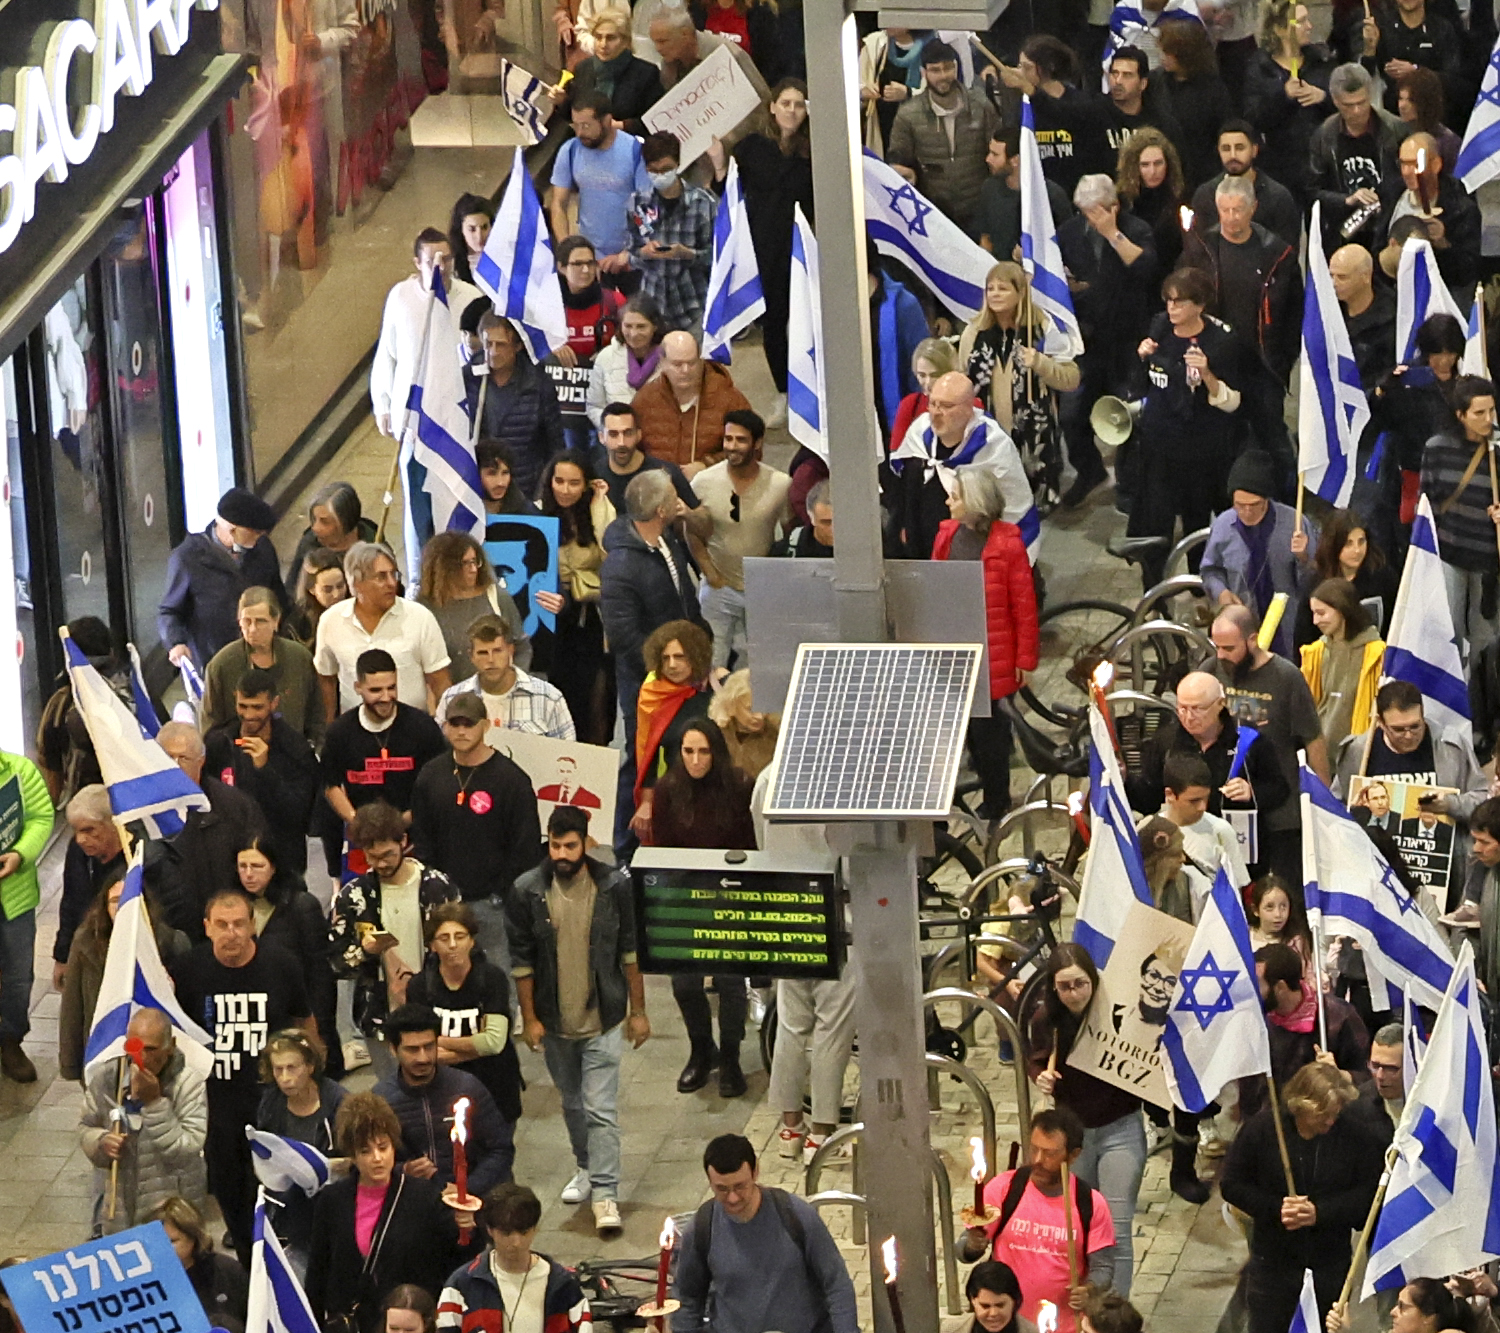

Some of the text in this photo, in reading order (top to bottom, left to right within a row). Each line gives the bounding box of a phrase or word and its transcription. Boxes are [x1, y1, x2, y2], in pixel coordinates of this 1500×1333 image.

[214, 992, 268, 1023] דמו
[214, 1022, 268, 1058] קרט
[214, 1052, 241, 1080] יה
[1097, 1048, 1157, 1089] BGZ
[32, 1238, 154, 1304] כולנו
